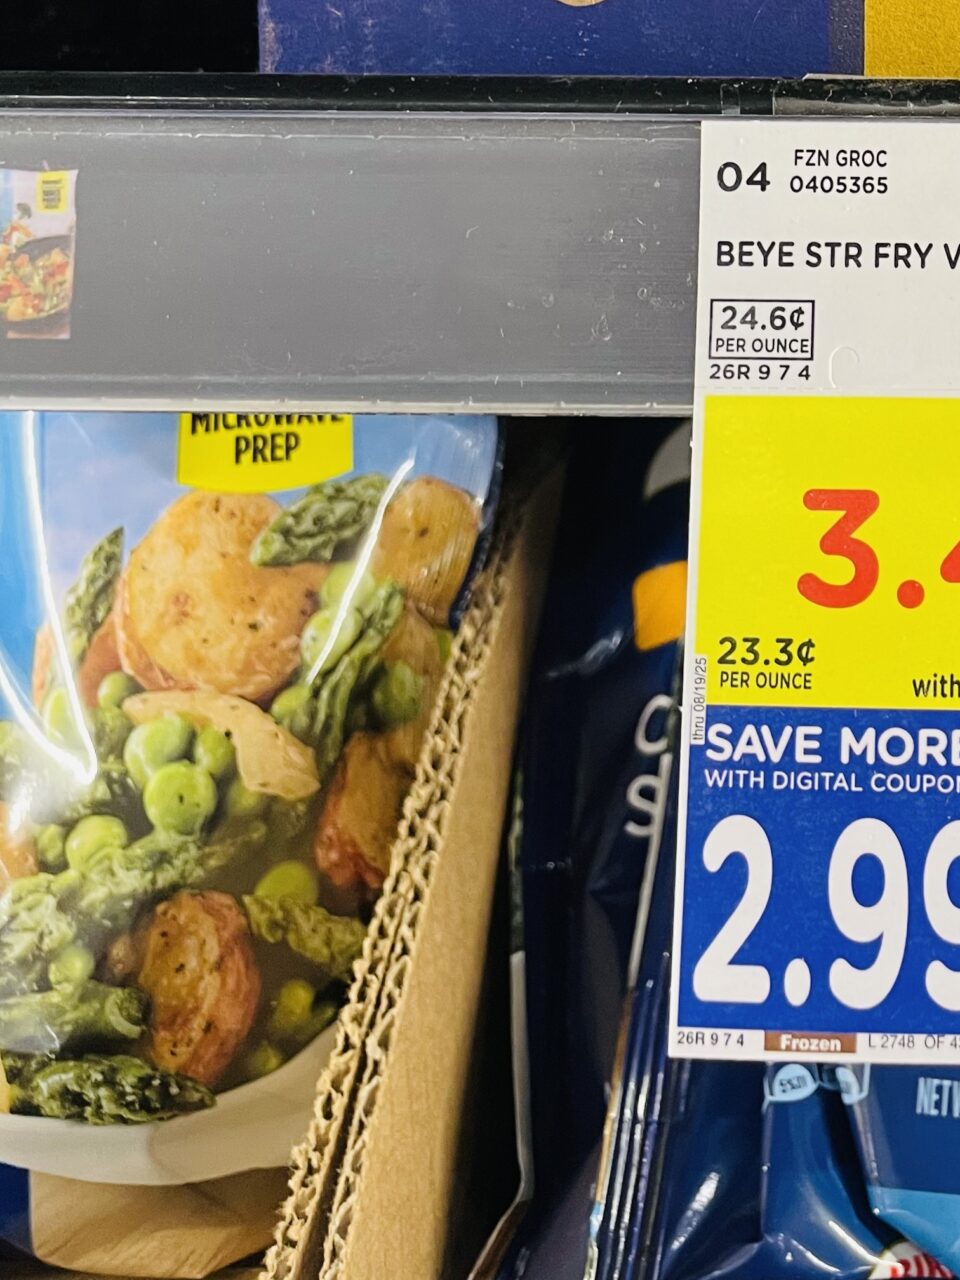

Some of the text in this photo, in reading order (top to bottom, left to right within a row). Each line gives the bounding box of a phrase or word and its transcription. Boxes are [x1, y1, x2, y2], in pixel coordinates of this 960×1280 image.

[794, 149, 888, 169] FZN GROC
[716, 161, 770, 193] 04
[788, 176, 889, 195] 0405365
[716, 240, 796, 269] BEYE
[805, 241, 863, 270] STR
[874, 242, 934, 270] FRY
[715, 337, 811, 356] PER OUNCE
[709, 364, 812, 382] 26R 9 7 4
[234, 431, 300, 465] PREP
[718, 671, 813, 691] PER OUNCE
[691, 656, 708, 741] thru 08/19/25
[705, 723, 824, 766] SAVE
[704, 769, 766, 791] WITH
[772, 770, 864, 793] DIGITAL
[677, 1031, 705, 1046] 26R
[711, 1031, 720, 1046] 9
[724, 1032, 733, 1046] 7
[736, 1032, 745, 1046] 4
[779, 1033, 842, 1053] Frozen
[867, 1033, 876, 1048] L
[880, 1034, 916, 1049] 2748
[923, 1035, 946, 1050] OF
